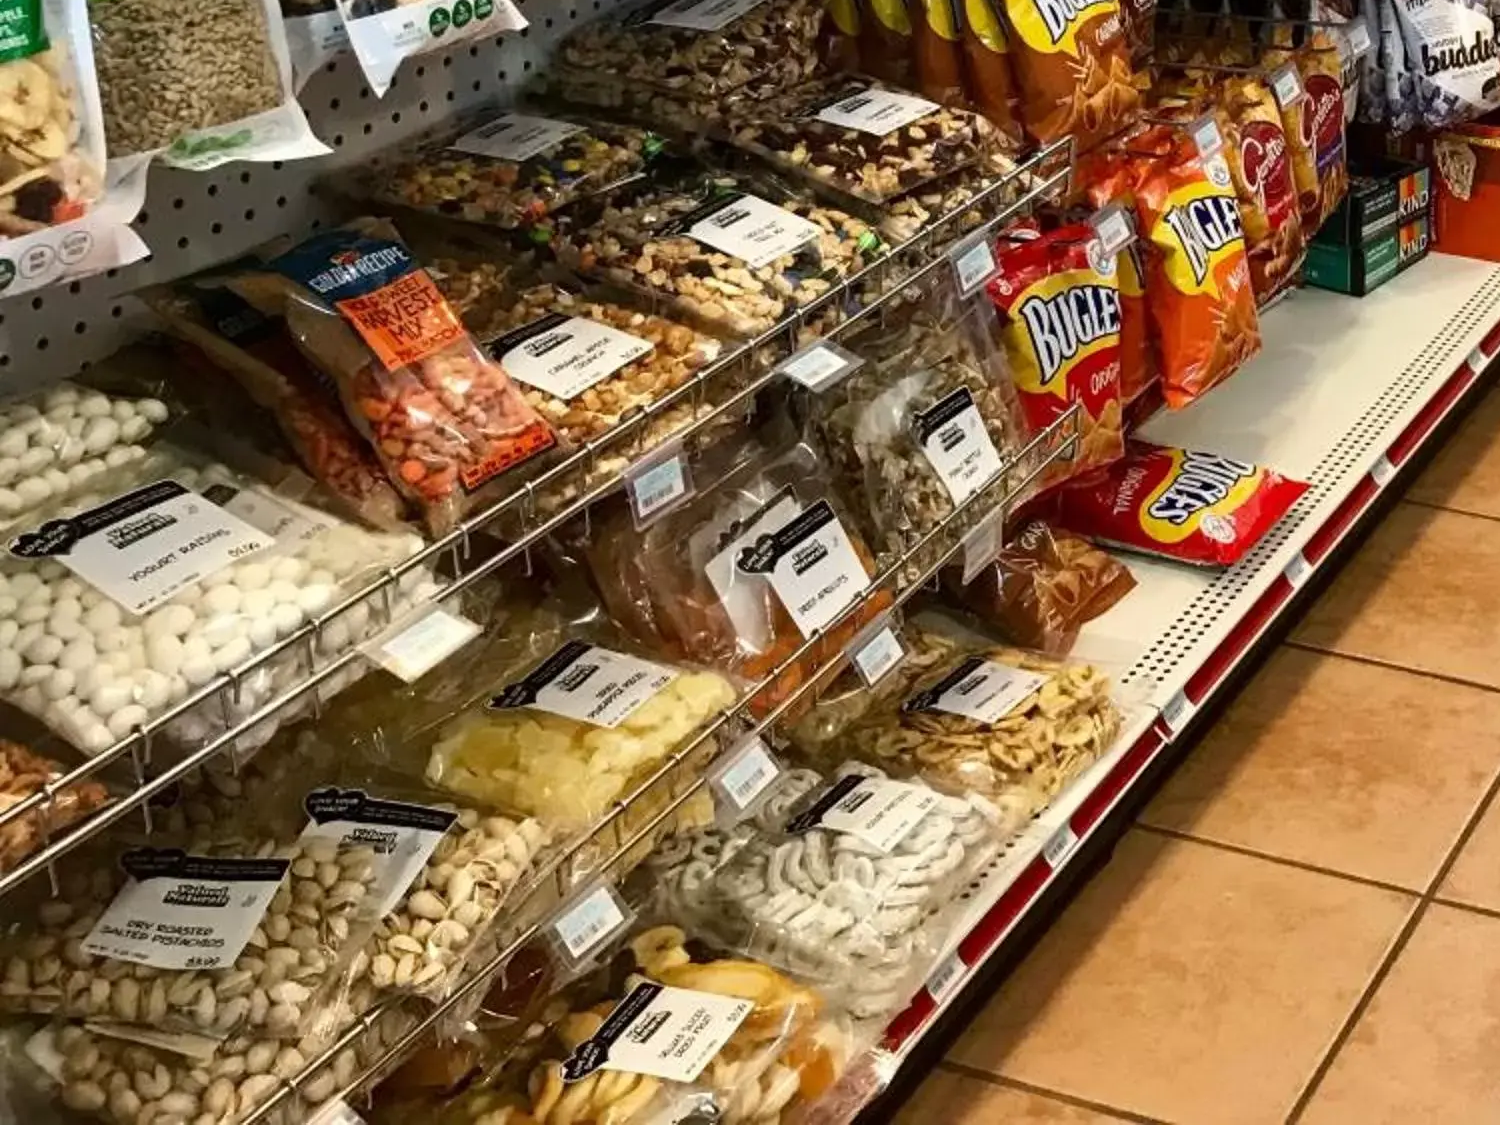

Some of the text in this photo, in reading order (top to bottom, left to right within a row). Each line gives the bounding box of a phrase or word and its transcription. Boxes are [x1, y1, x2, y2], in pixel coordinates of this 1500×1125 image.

[1398, 190, 1429, 217] KIND
[354, 245, 411, 274] RECIPE
[1400, 234, 1428, 263] KIND
